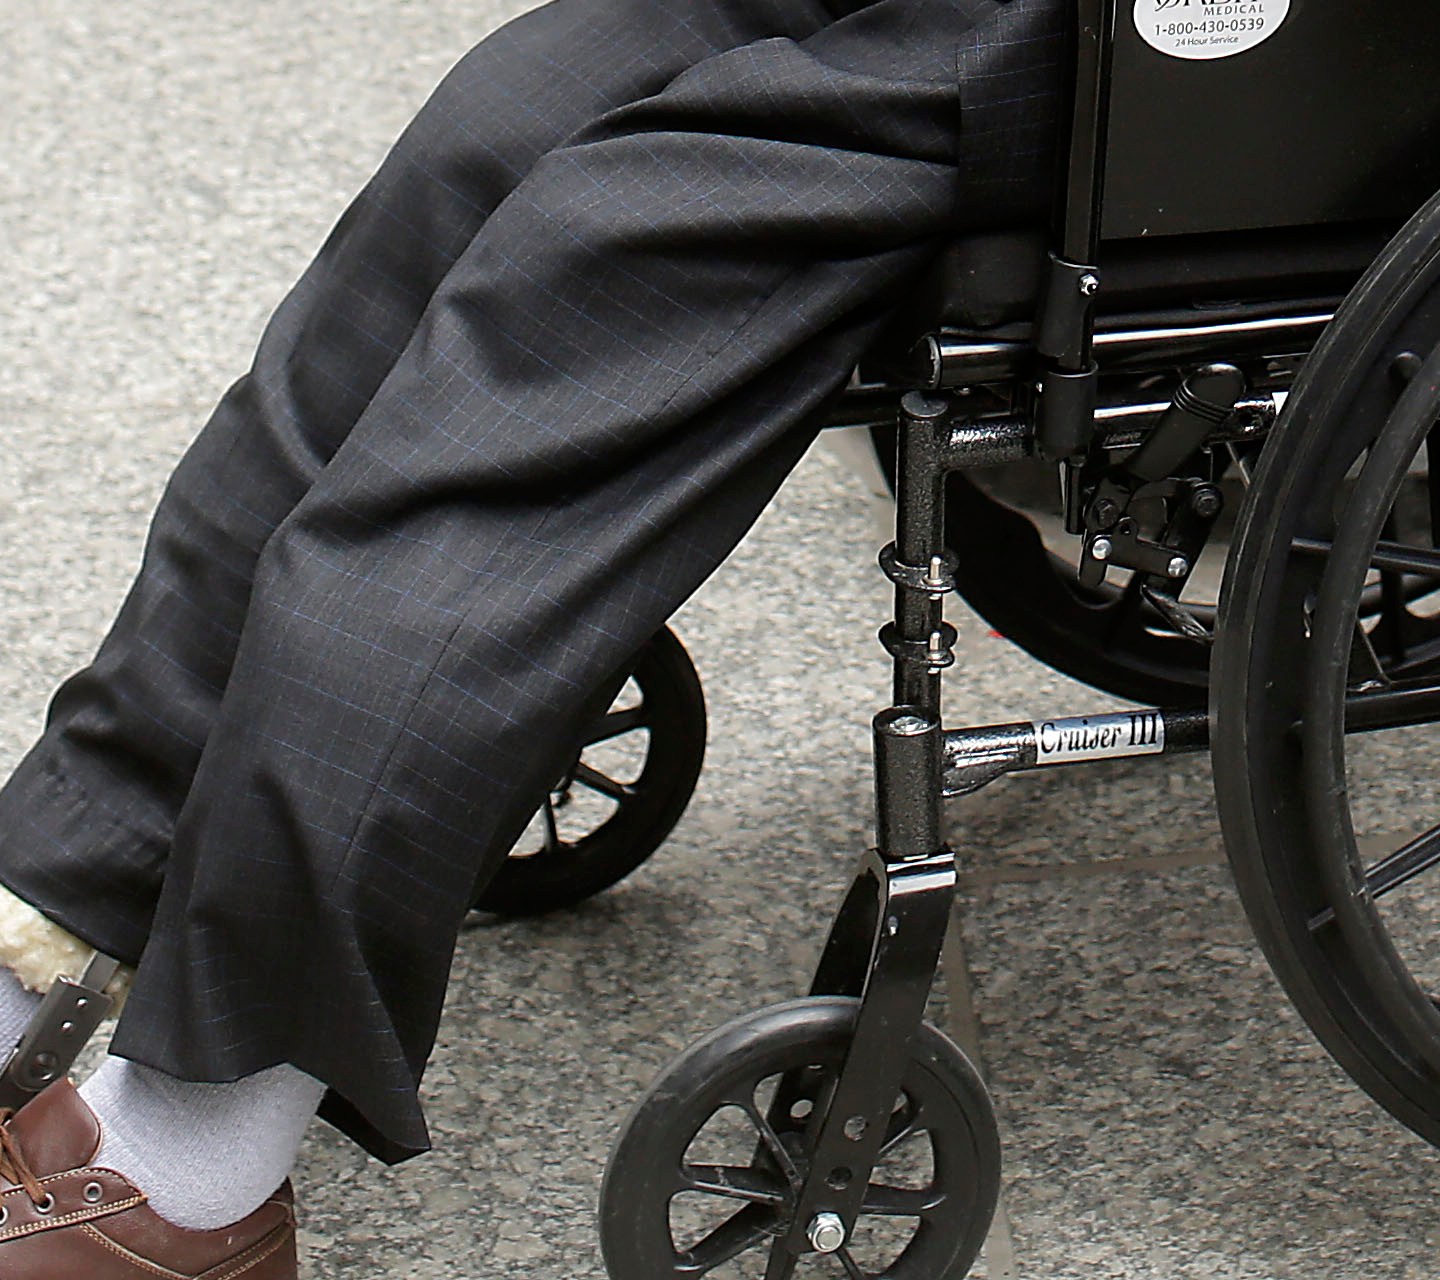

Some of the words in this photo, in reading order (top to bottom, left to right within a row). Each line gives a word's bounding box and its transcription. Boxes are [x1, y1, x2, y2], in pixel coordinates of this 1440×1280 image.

[1203, 3, 1265, 17] MEDICAL
[1154, 17, 1265, 37] 1-800-430-0539
[1175, 38, 1186, 47] 24
[1187, 37, 1208, 46] Hour
[1209, 35, 1239, 45] Service
[1040, 719, 1122, 754] Cruiser
[1126, 712, 1159, 746] III
